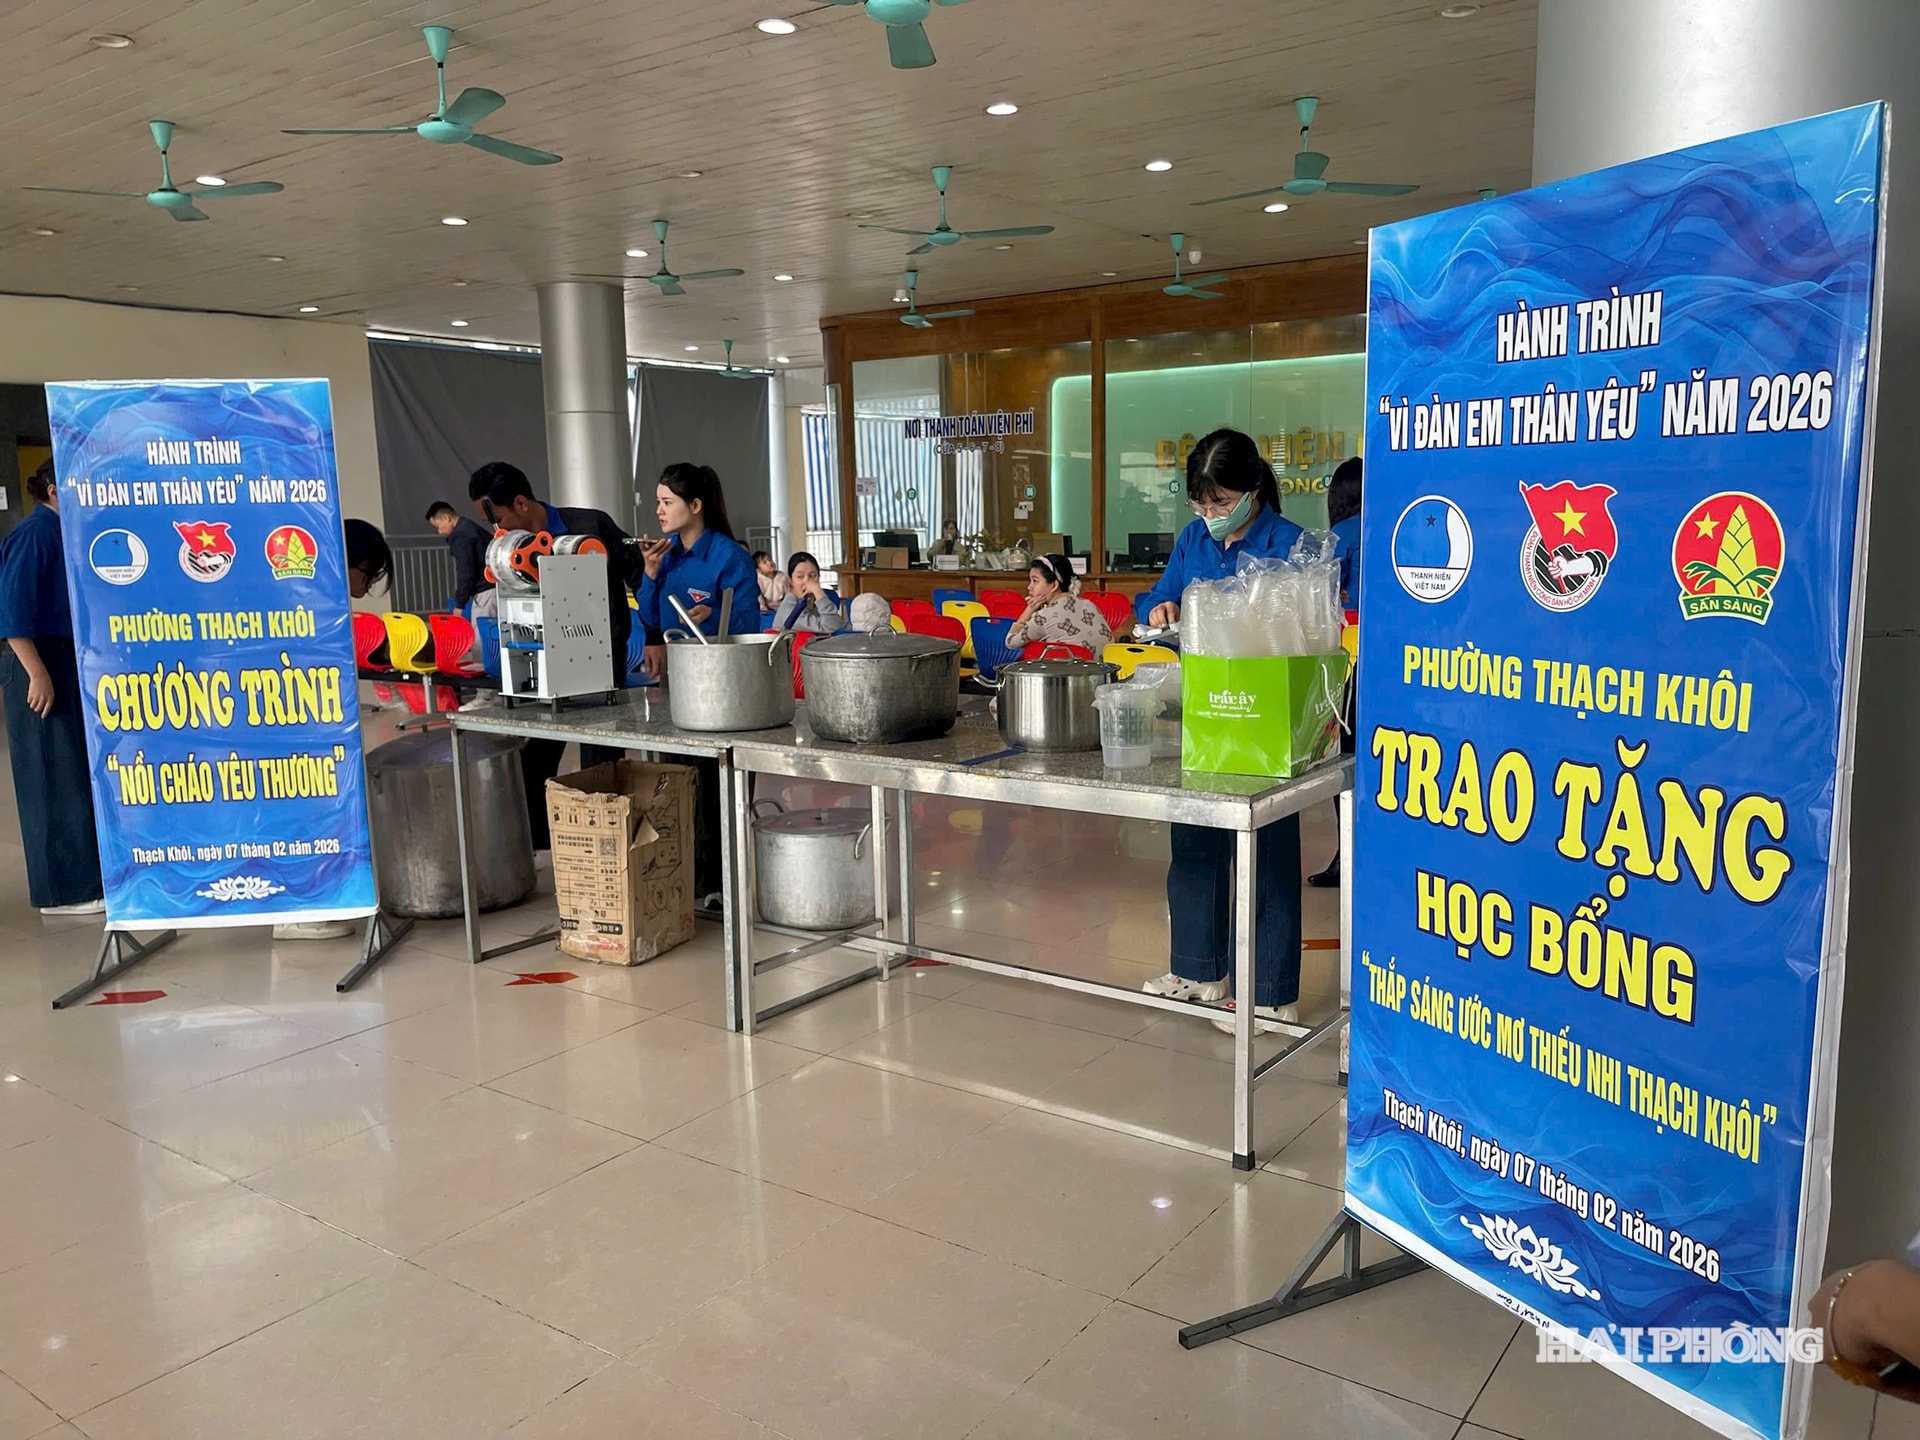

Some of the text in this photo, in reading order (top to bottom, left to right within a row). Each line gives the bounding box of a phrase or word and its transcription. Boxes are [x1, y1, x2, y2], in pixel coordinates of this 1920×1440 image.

[1497, 286, 1663, 362] HÀNH TRÌNH
[904, 408, 1034, 440] NƠI THANH TOÁN VIỆN PHÍ
[1414, 394, 1460, 449] ĐÀN
[1466, 398, 1502, 447] EM
[1510, 384, 1582, 445] THÂN
[1662, 370, 1738, 436] NĂM
[1746, 370, 1833, 433] 2026
[147, 436, 241, 465] HÀNH TRÌNH
[96, 477, 130, 506] ĐÀN
[134, 482, 158, 506] EM
[162, 477, 201, 505] THÂN
[250, 476, 286, 504] NĂM
[289, 480, 326, 502] 2026
[1410, 572, 1451, 580] THANH NIÊN
[1722, 598, 1762, 616] SÀNG
[109, 606, 316, 645] PHƯỜNG THẠCH KHÔI
[98, 651, 344, 732] CHƯƠNG TRÌNH
[1403, 644, 1522, 700] PHƯỜNG
[1532, 660, 1644, 720] THẠCH
[1655, 669, 1753, 733] KHÔI
[160, 754, 214, 804] CHÁO
[218, 752, 256, 801] YÊU
[1372, 725, 1793, 904] TRAO TẶNG
[132, 839, 340, 866] Thạch Khôi, ngày 07 tháng 02 năm 2026
[1416, 870, 1696, 1026] HỌC BỔNG
[1410, 976, 1454, 1034] SÁNG
[1458, 994, 1492, 1049] ƯỚC
[1496, 1012, 1524, 1063] MƠ
[1529, 1026, 1581, 1087] THIẾU
[1586, 1049, 1622, 1106] NHI
[1627, 1065, 1698, 1134] THẠCH
[1382, 1088, 1720, 1284] Thạch Khôi, ngày 07 tháng 02 năm 2026
